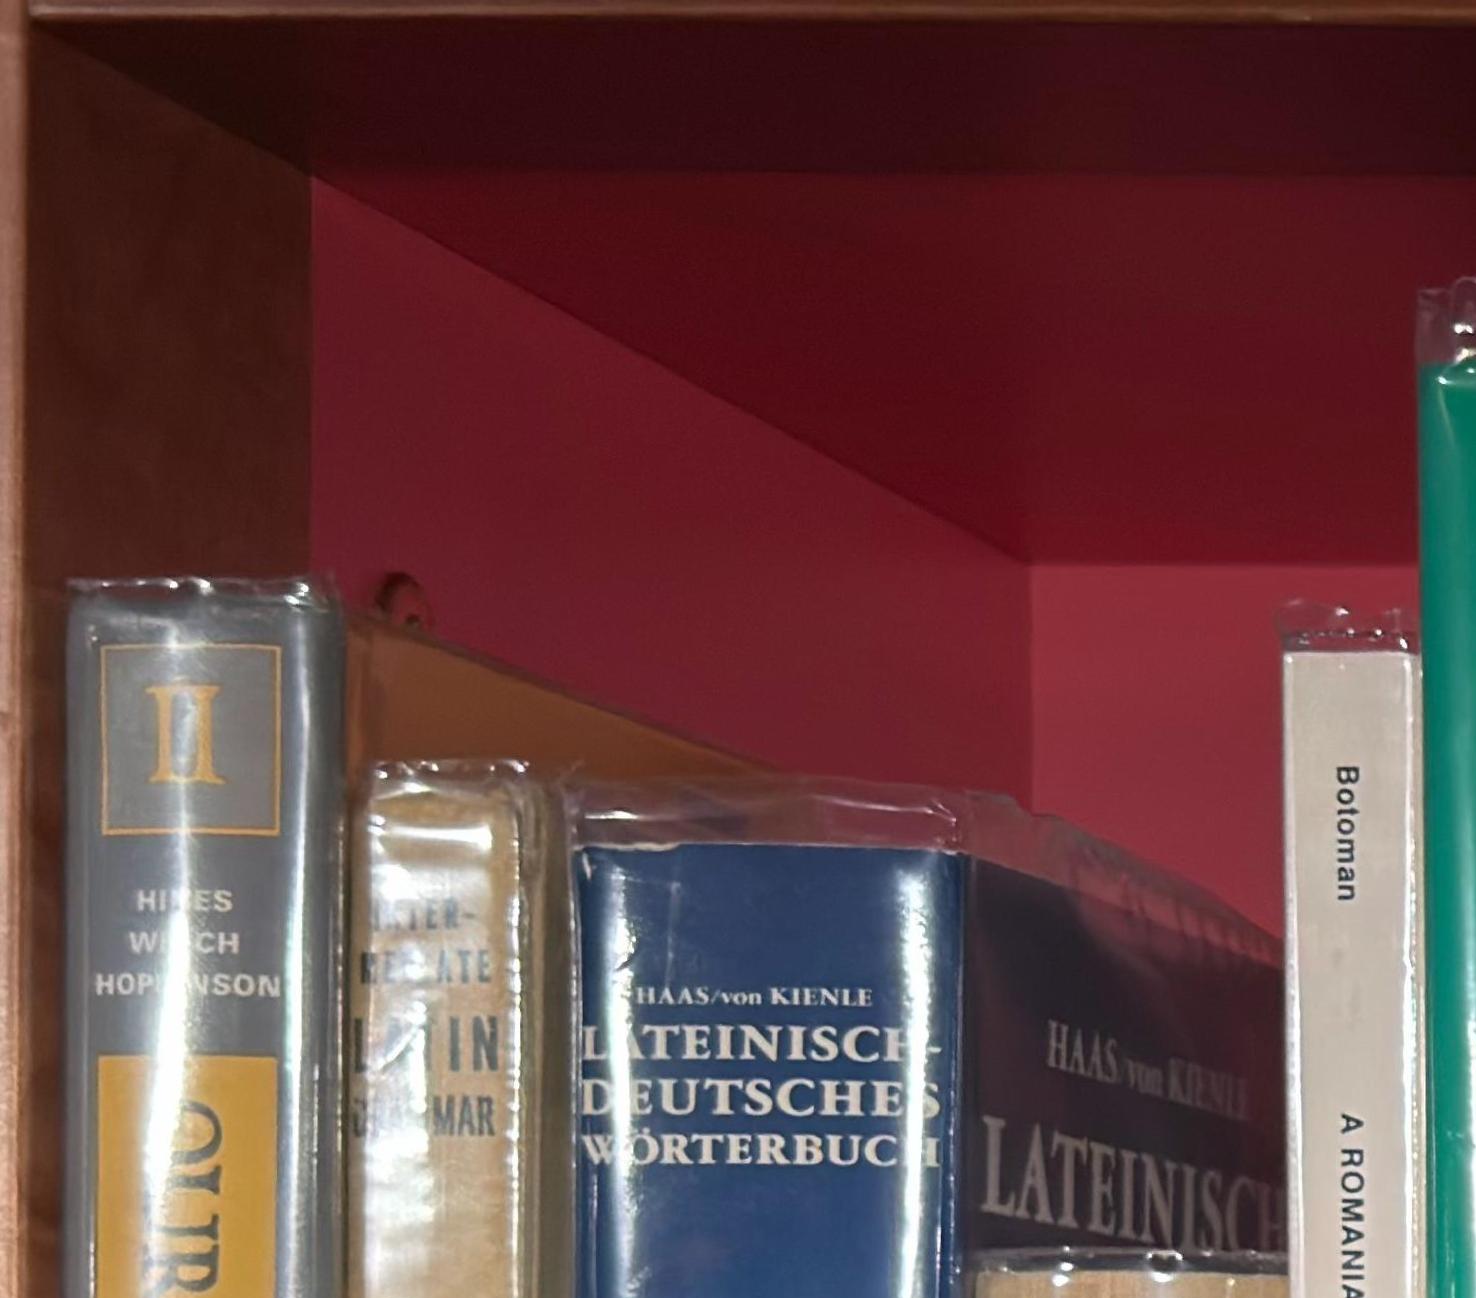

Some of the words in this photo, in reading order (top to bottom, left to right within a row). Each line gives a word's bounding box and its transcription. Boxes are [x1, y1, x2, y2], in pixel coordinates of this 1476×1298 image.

[145, 685, 226, 785] II
[1335, 764, 1359, 903] Botoman
[137, 889, 233, 912] HIES
[129, 931, 241, 955] WCH
[361, 949, 492, 984] MEATE
[95, 973, 281, 998] HOPNSON
[635, 985, 762, 1008] HAAS/von
[770, 986, 873, 1008] KIENLE
[581, 1077, 941, 1118] DEUTSCHES
[352, 1095, 496, 1137] GMAR
[1340, 1112, 1364, 1136] A
